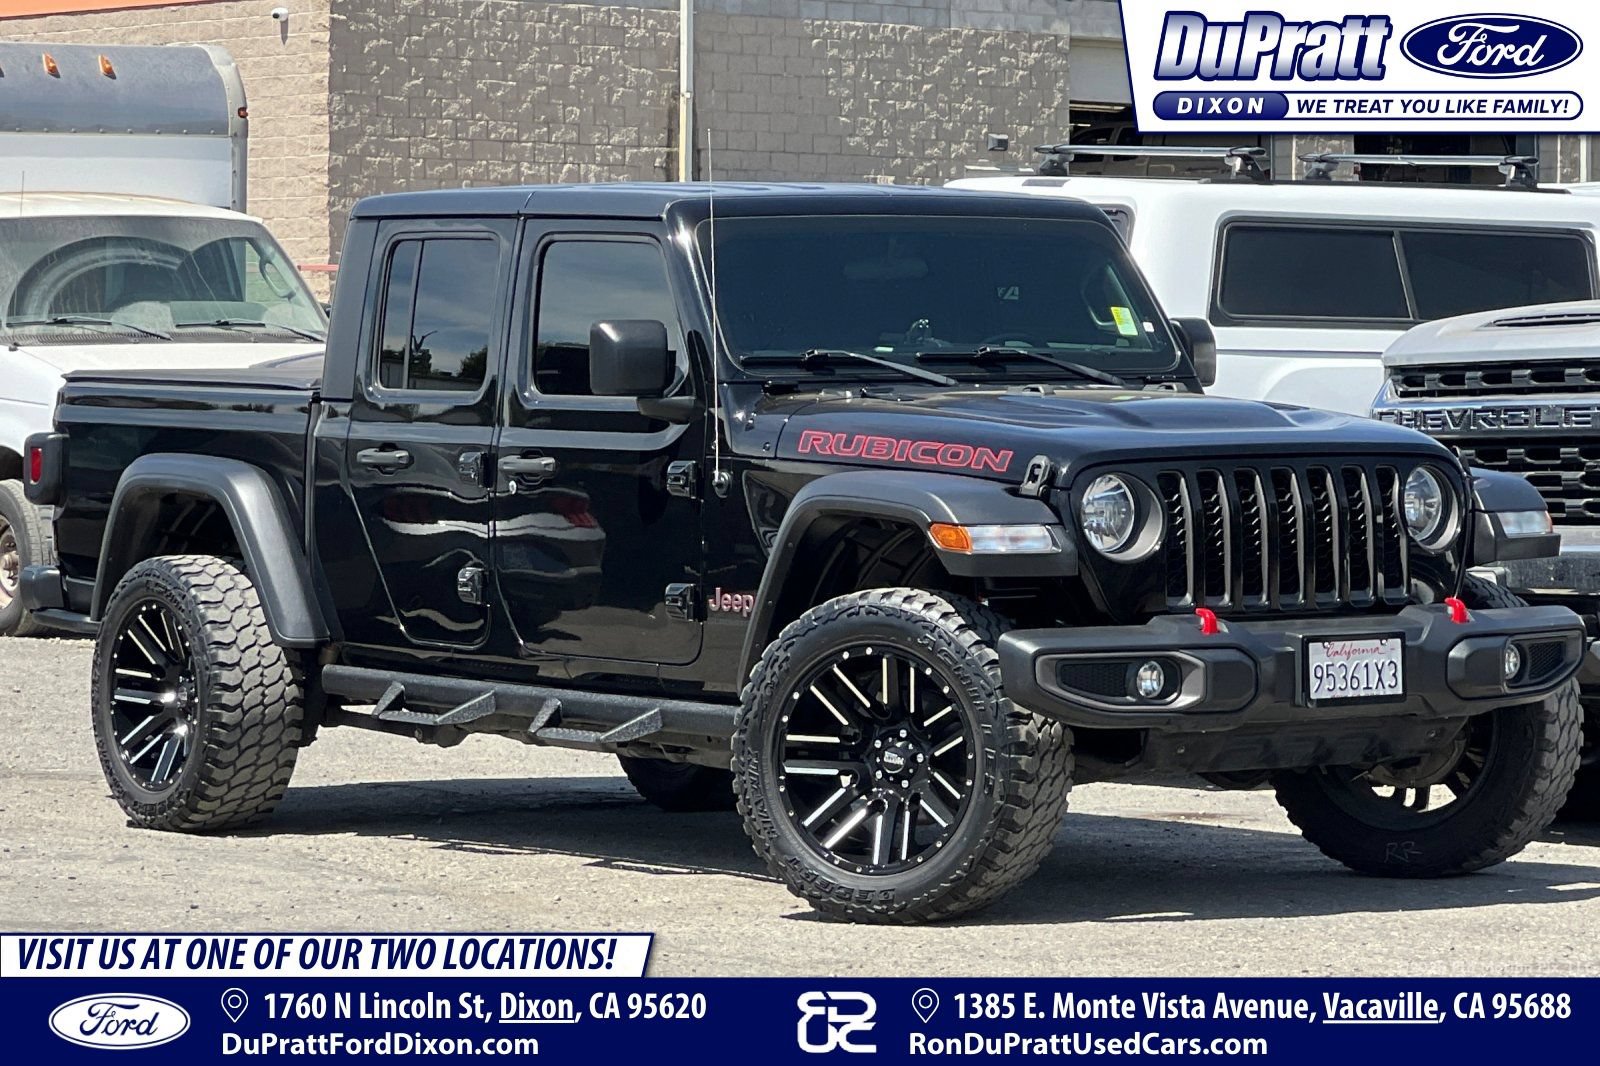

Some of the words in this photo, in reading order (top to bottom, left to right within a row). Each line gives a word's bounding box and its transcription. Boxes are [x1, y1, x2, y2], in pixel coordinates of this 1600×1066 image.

[1378, 405, 1600, 430] CHEVROLE
[798, 430, 1013, 472] RUBICON
[708, 587, 754, 617] Jeep
[1326, 641, 1389, 661] California
[1313, 660, 1398, 693] 95361X3
